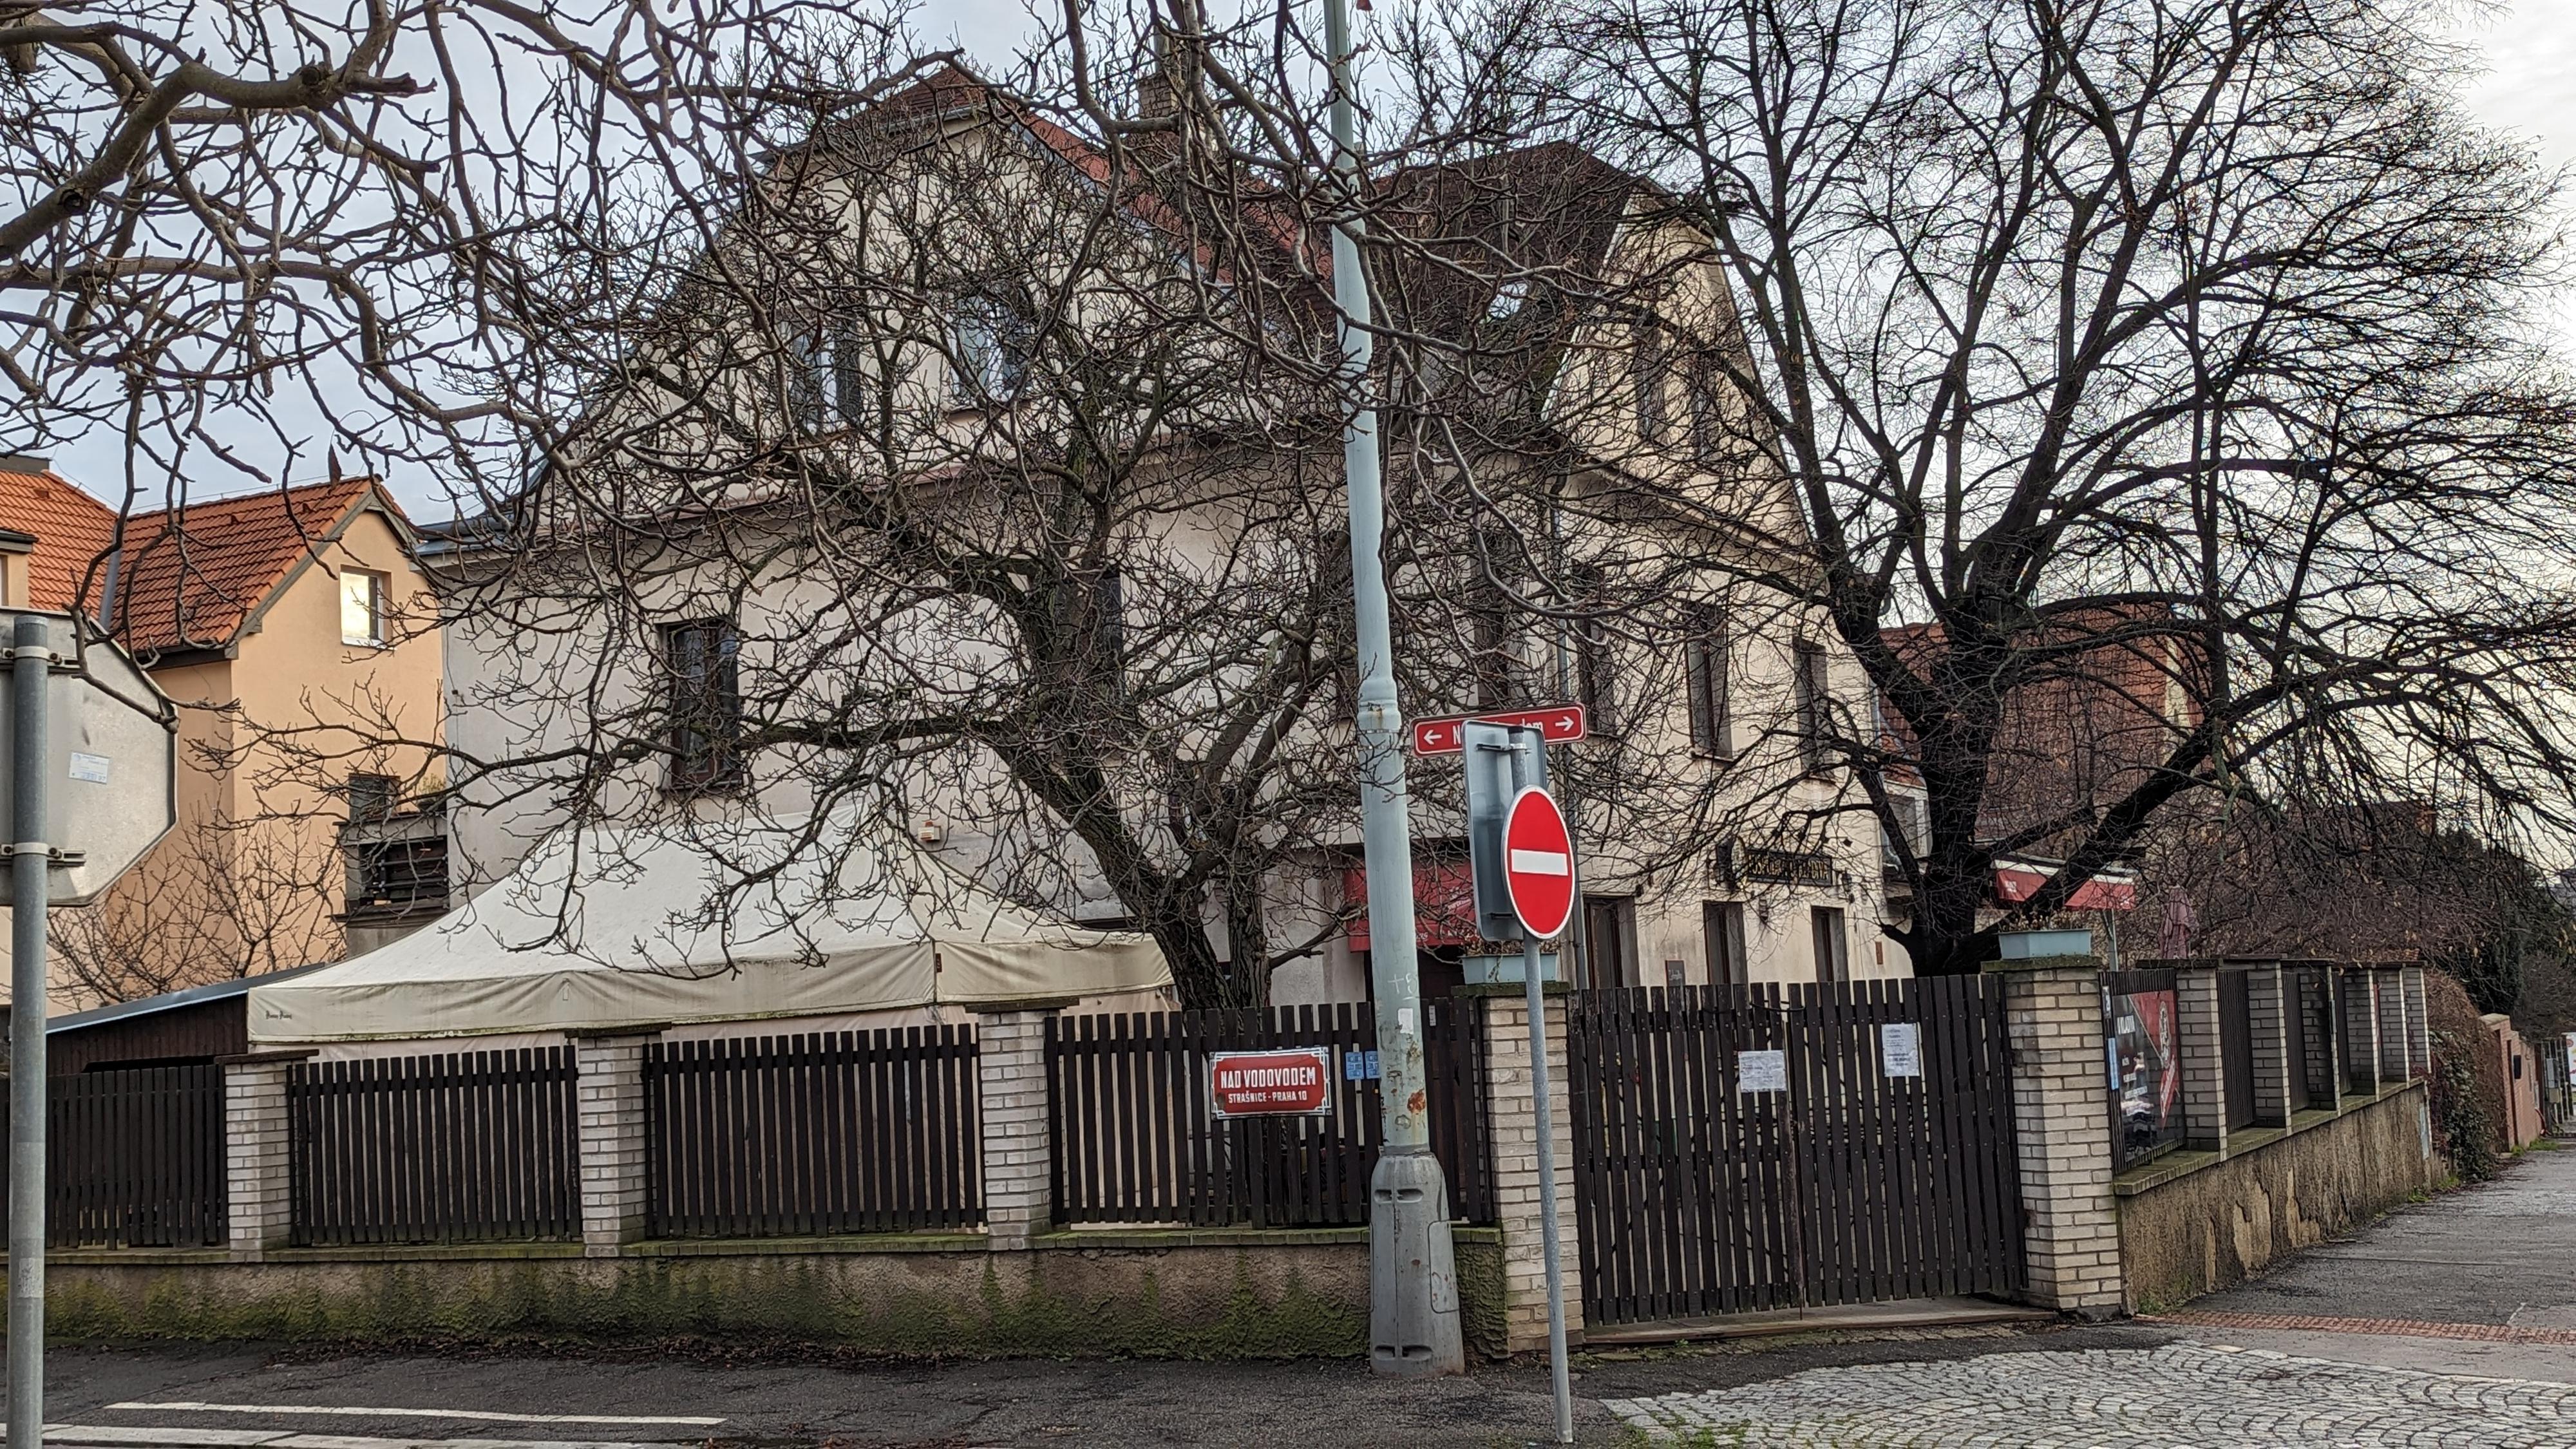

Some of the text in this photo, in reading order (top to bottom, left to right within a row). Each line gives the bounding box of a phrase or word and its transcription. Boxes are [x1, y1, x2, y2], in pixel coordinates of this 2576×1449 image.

[1220, 1066, 1316, 1089] NAD VODOVODEM
[1228, 1090, 1267, 1104] STRAŠNICE
[1272, 1091, 1297, 1102] PRAHA
[1298, 1090, 1308, 1101] 10
